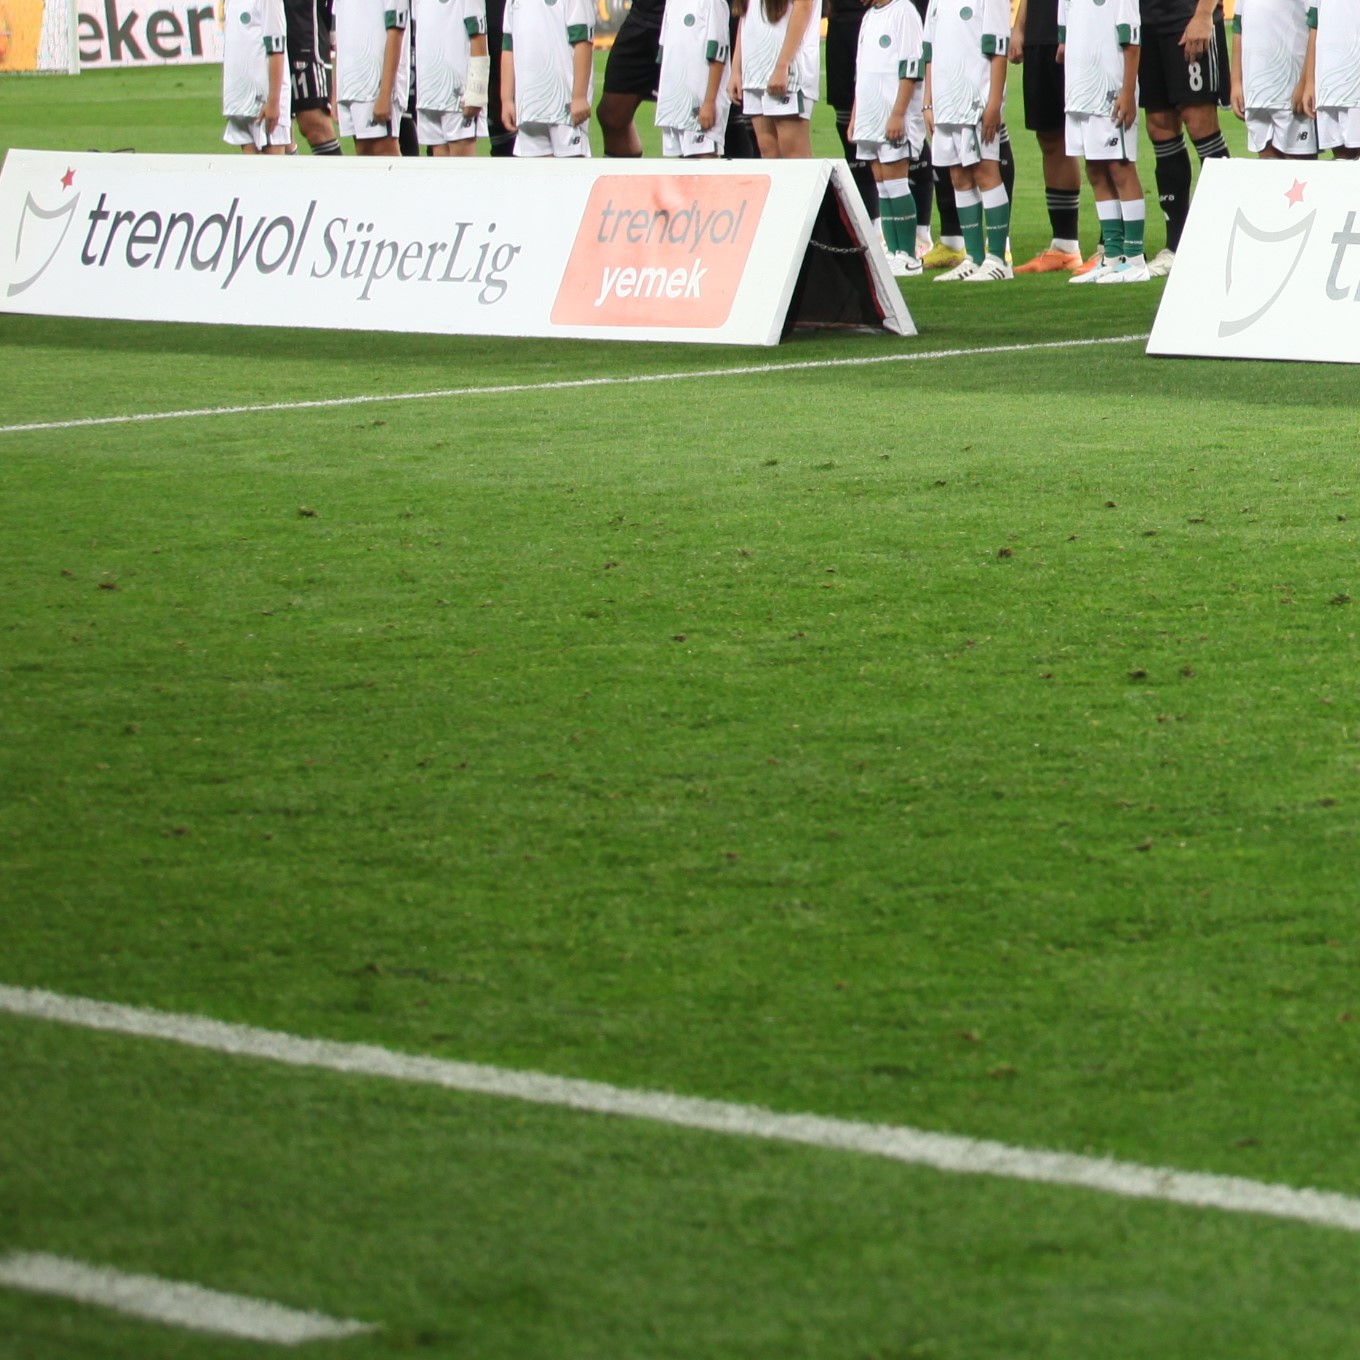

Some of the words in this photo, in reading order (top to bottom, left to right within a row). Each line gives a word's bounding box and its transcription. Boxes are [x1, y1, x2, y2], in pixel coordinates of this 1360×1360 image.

[1188, 61, 1204, 92] 8
[598, 197, 749, 247] trendyol
[80, 190, 315, 291] trendyol
[312, 218, 522, 306] SüperLig
[595, 257, 709, 306] yemek
